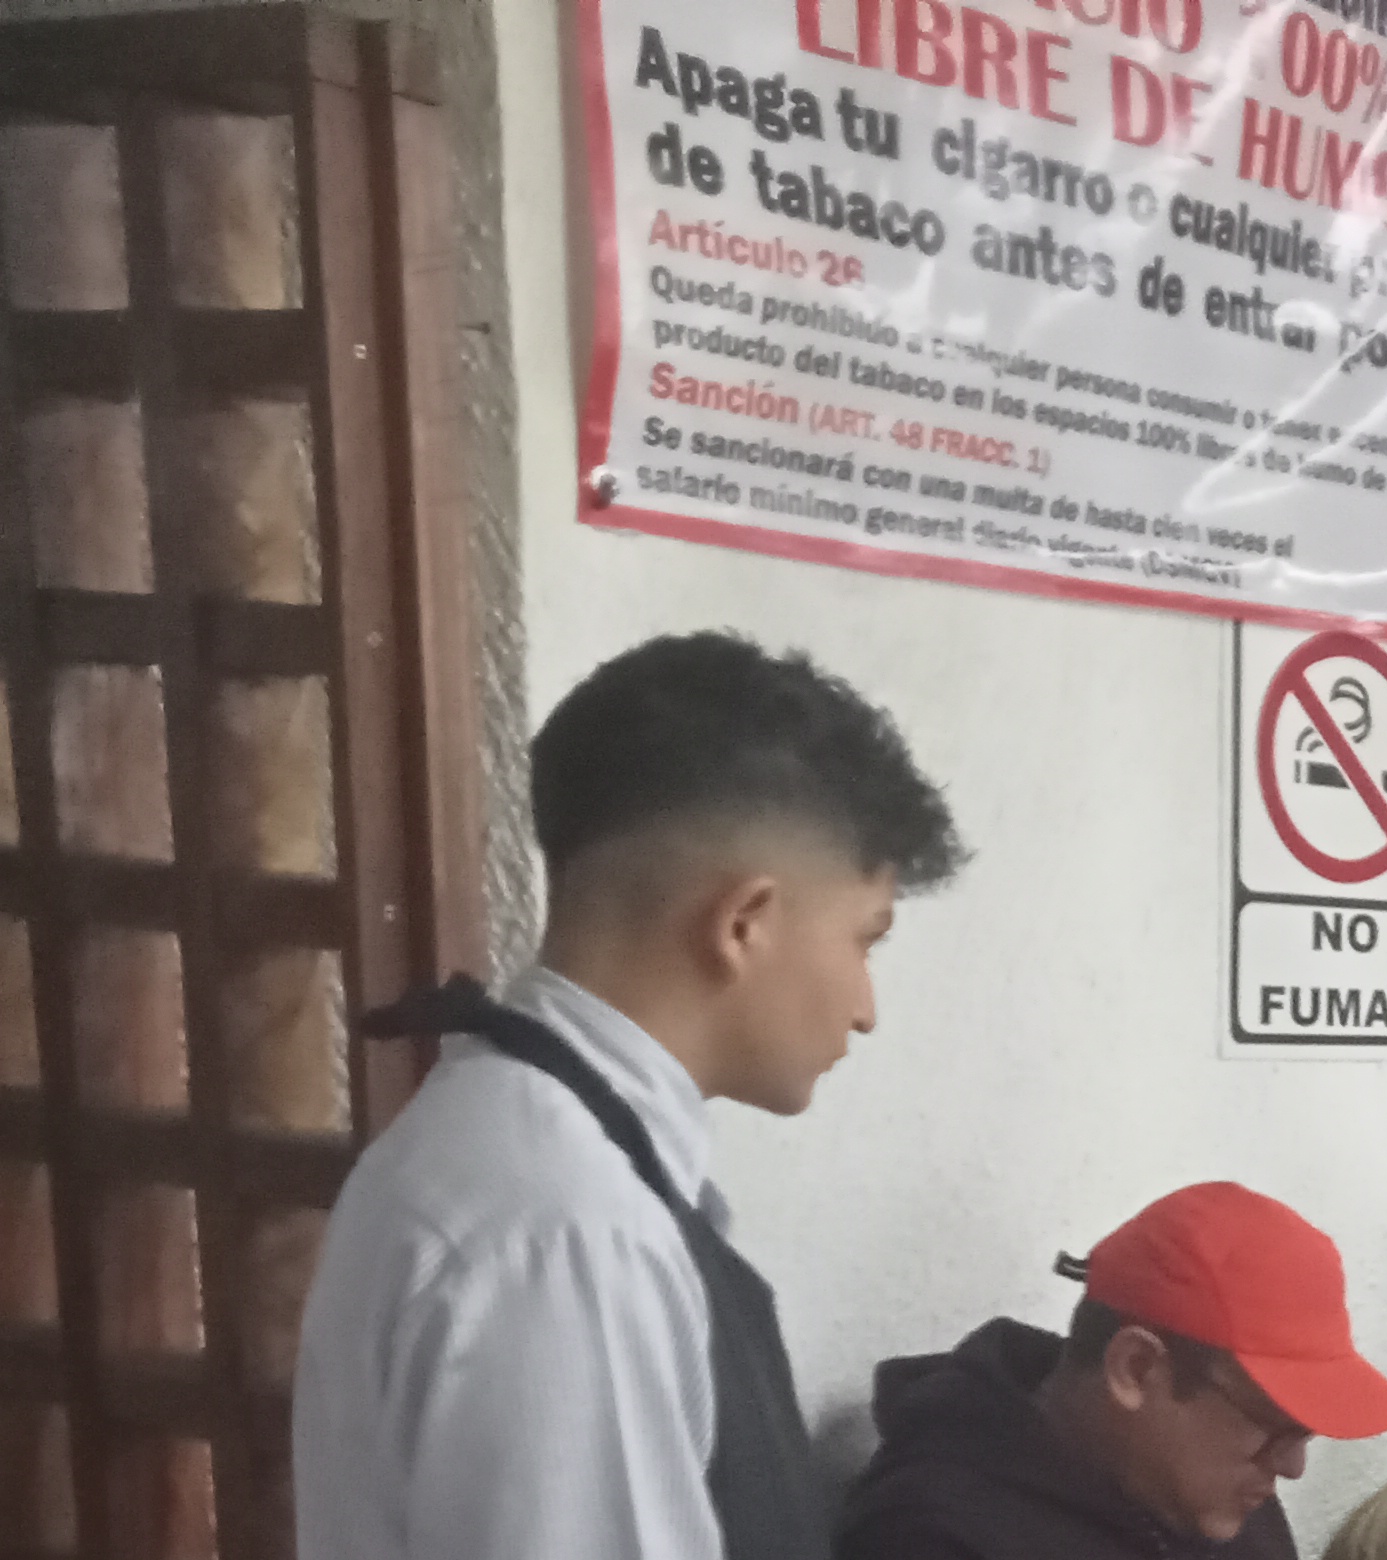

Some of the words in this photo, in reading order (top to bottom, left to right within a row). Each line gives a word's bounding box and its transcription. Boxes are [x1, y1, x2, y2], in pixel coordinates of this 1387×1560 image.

[636, 25, 825, 143] Apaga
[834, 86, 900, 160] tu
[932, 118, 1114, 215] cigarro
[1127, 183, 1158, 226] o
[796, 0, 1076, 126] LIBRE
[1111, 55, 1213, 166] DE
[646, 122, 725, 197] de
[750, 148, 946, 257] tabaco
[971, 223, 1117, 298] antes
[1139, 255, 1186, 317] de
[649, 209, 807, 278] Artículo
[651, 265, 753, 315] Queda
[650, 362, 799, 424] Sanción
[808, 402, 881, 441] (ART.
[653, 319, 786, 367] producto
[794, 344, 841, 379] del
[849, 356, 945, 401] tabaco
[953, 384, 984, 410] en
[992, 387, 1027, 419] los
[636, 465, 741, 505] salario
[864, 505, 965, 542] general
[643, 415, 682, 449] Se
[691, 431, 854, 482] sancionará
[863, 465, 911, 491] con
[919, 474, 966, 502] una
[971, 484, 1044, 515] multa
[1050, 495, 1079, 522] de
[1313, 911, 1379, 953] NO
